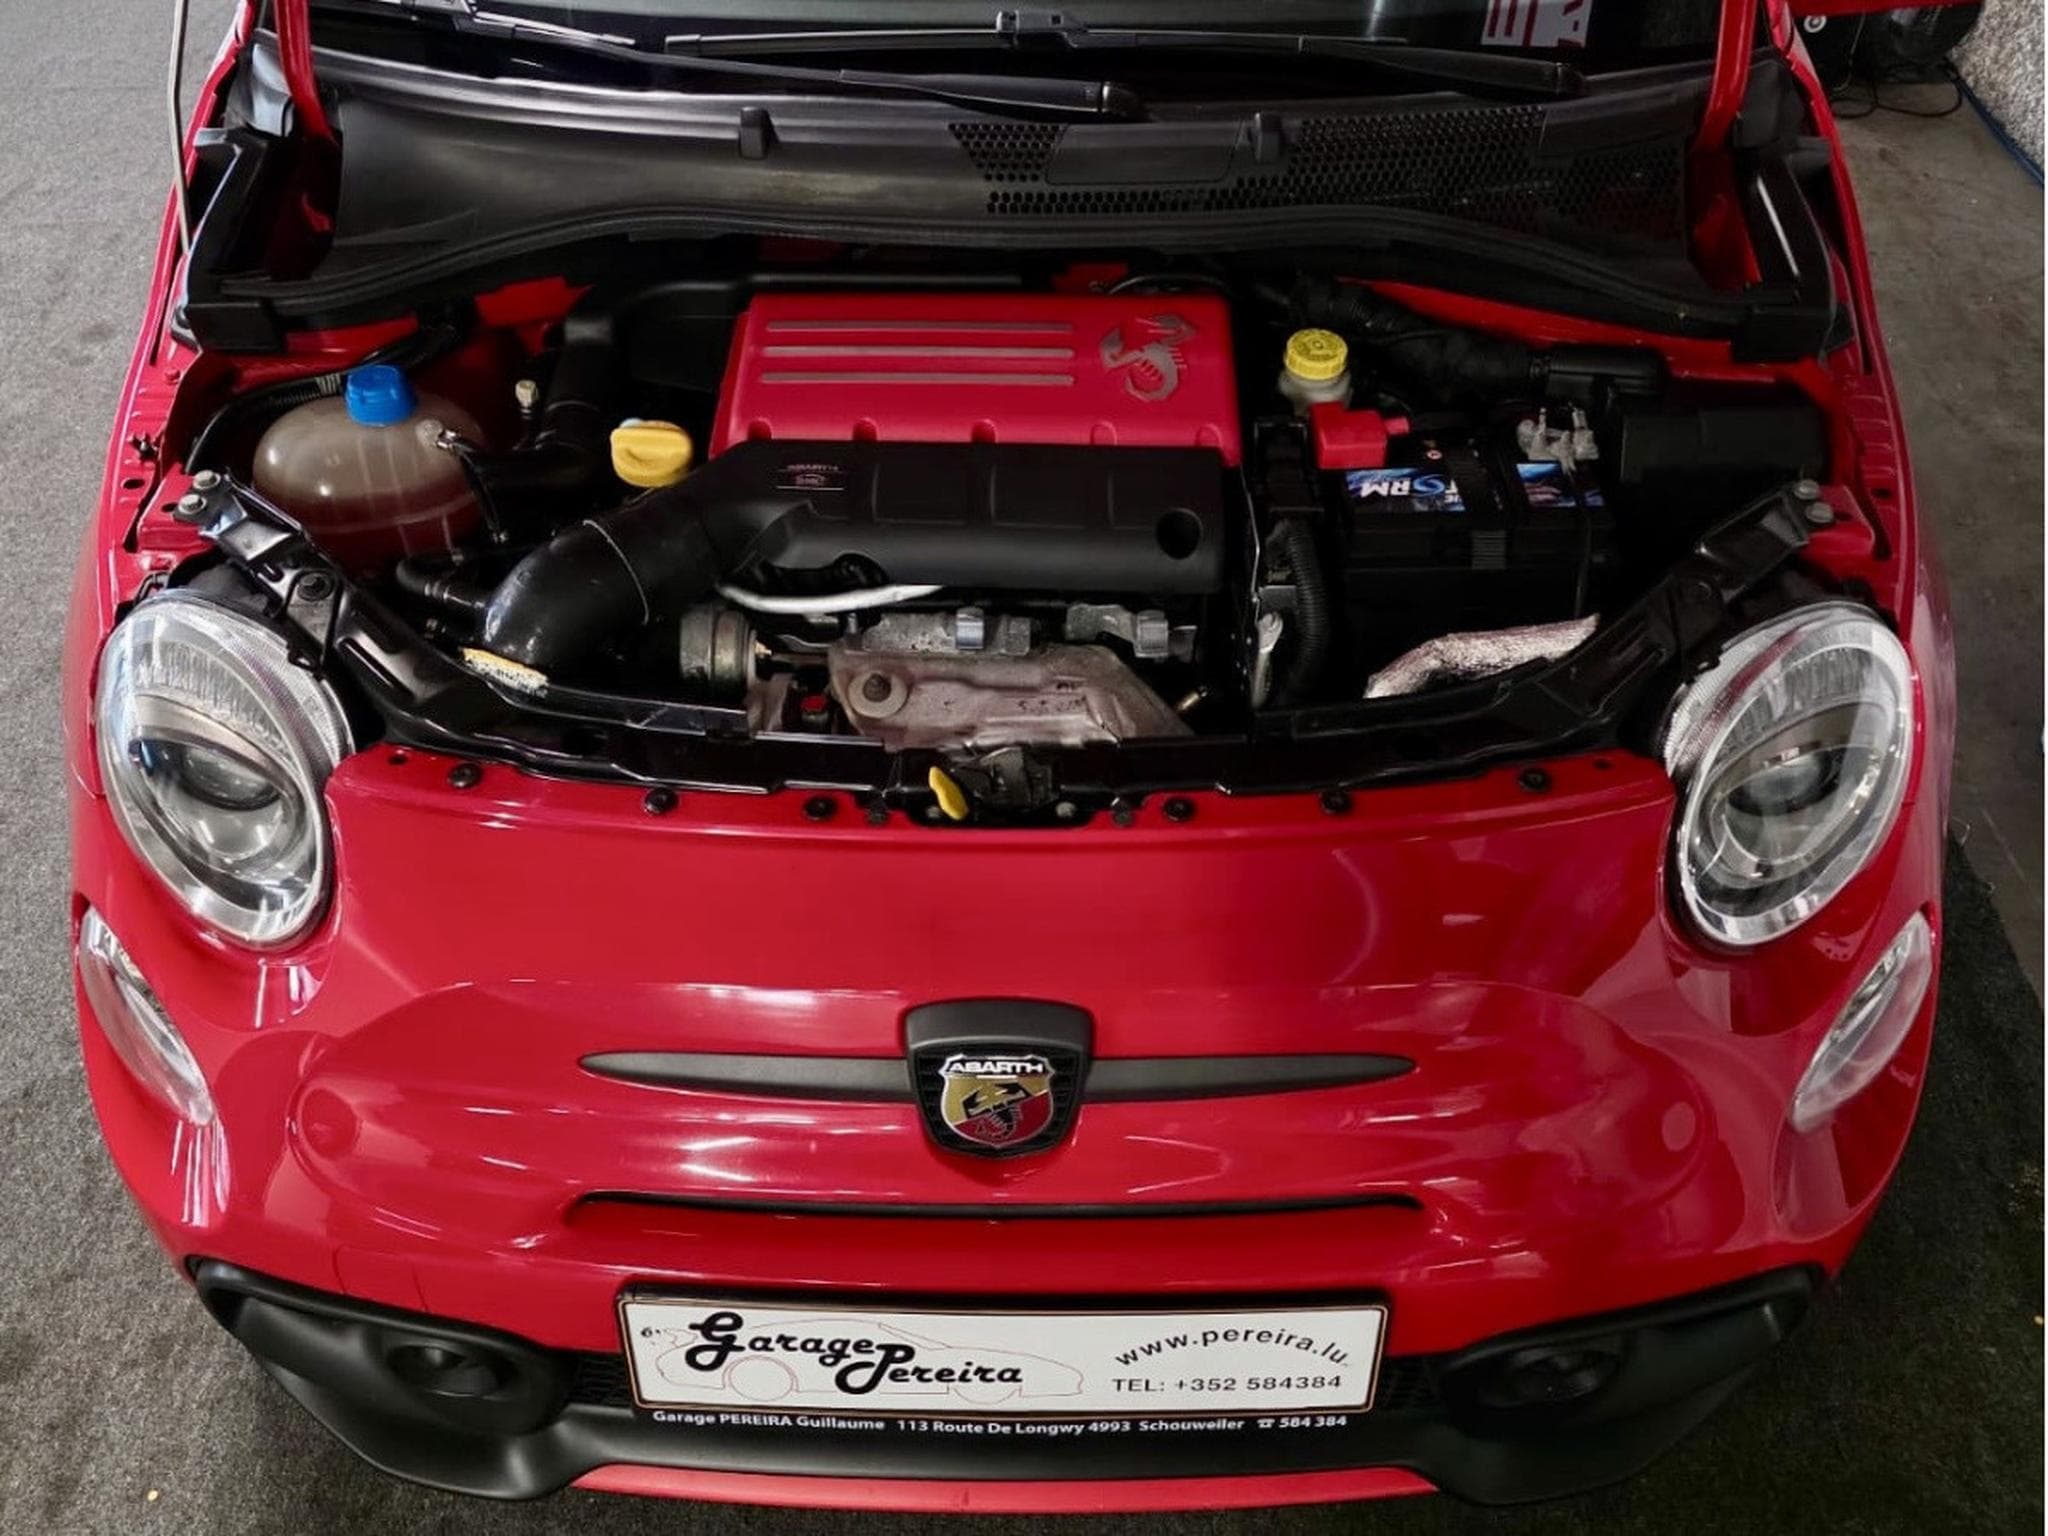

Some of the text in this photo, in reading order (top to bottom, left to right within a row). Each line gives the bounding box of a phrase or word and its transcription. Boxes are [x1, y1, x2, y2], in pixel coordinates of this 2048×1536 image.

[949, 1060, 1044, 1074] ABARTH
[684, 1311, 875, 1372] Garage
[1114, 1326, 1349, 1367] www.pereira.lu
[834, 1343, 1023, 1395] Pereira
[1112, 1375, 1342, 1393] TEL: +352 584384
[652, 1410, 1348, 1436] Garage PEREIRA Guillaume 113 Route De Longwy 4993 Schouweiler 584 384
